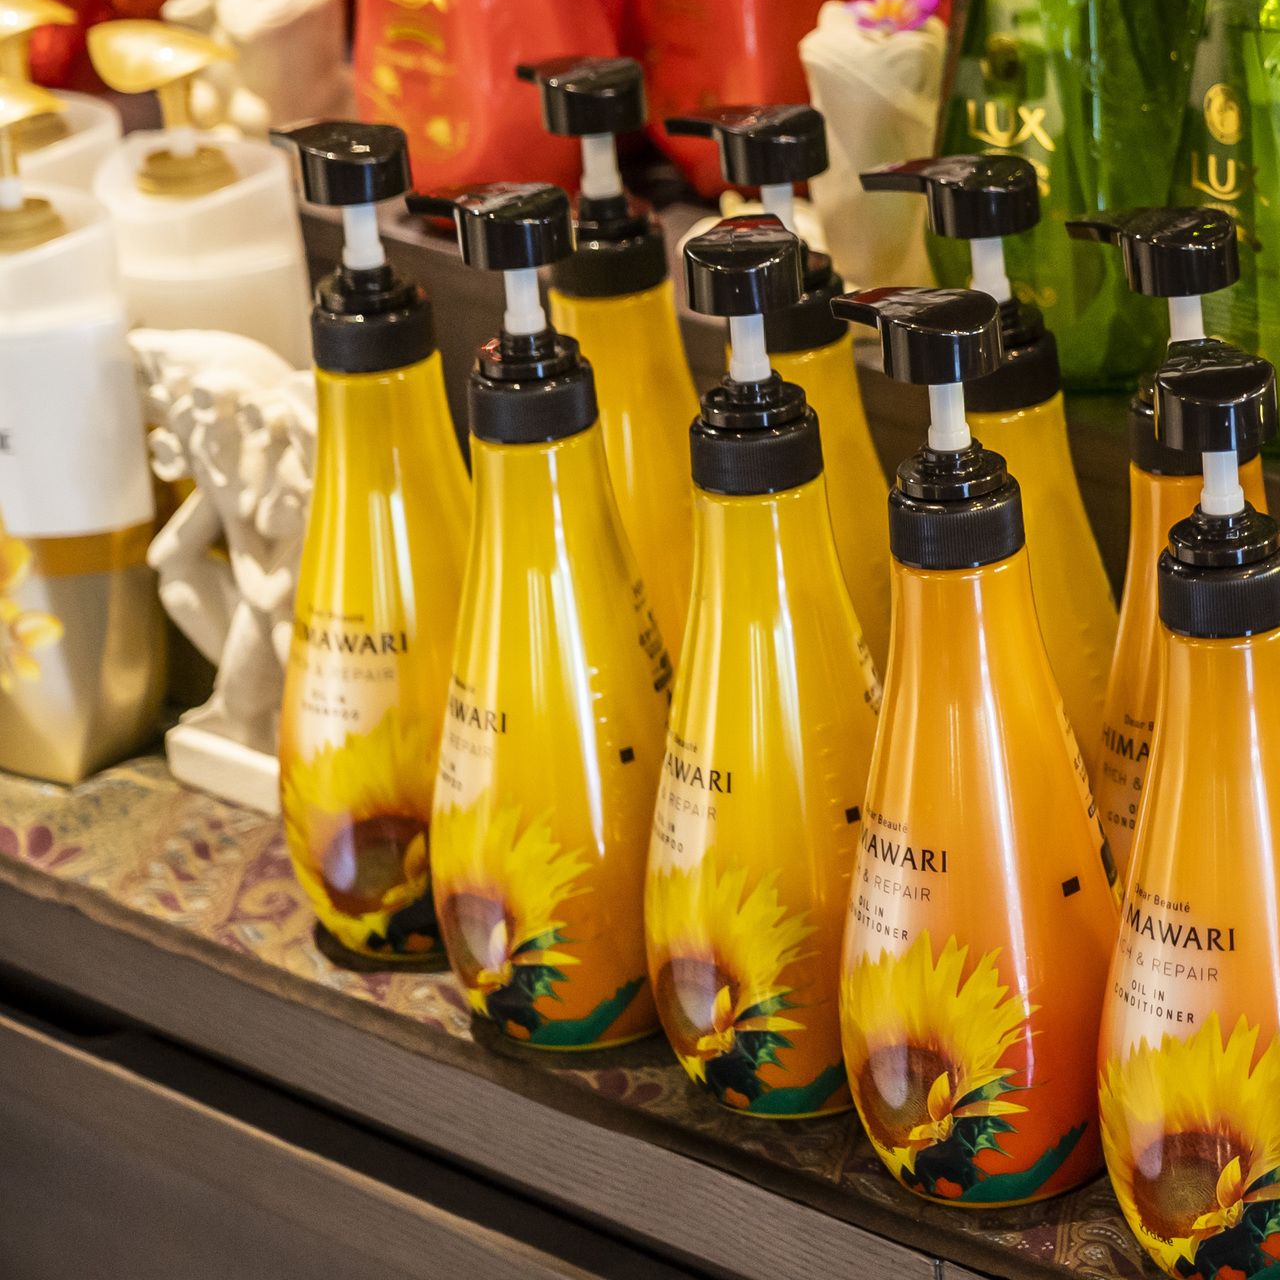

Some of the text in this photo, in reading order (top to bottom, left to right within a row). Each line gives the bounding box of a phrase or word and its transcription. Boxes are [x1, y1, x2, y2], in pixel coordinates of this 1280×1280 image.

[966, 99, 1056, 152] LUX
[1104, 723, 1150, 762] HIMA
[873, 875, 931, 902] REPAIR
[1153, 894, 1191, 914] Beauté
[874, 905, 884, 918] IN
[1126, 902, 1236, 952] MAWARI
[1136, 951, 1144, 967] &
[1151, 957, 1219, 983] REPAIR
[1115, 982, 1195, 1025] CONDITIONER
[1131, 979, 1165, 1002] OIL IN
